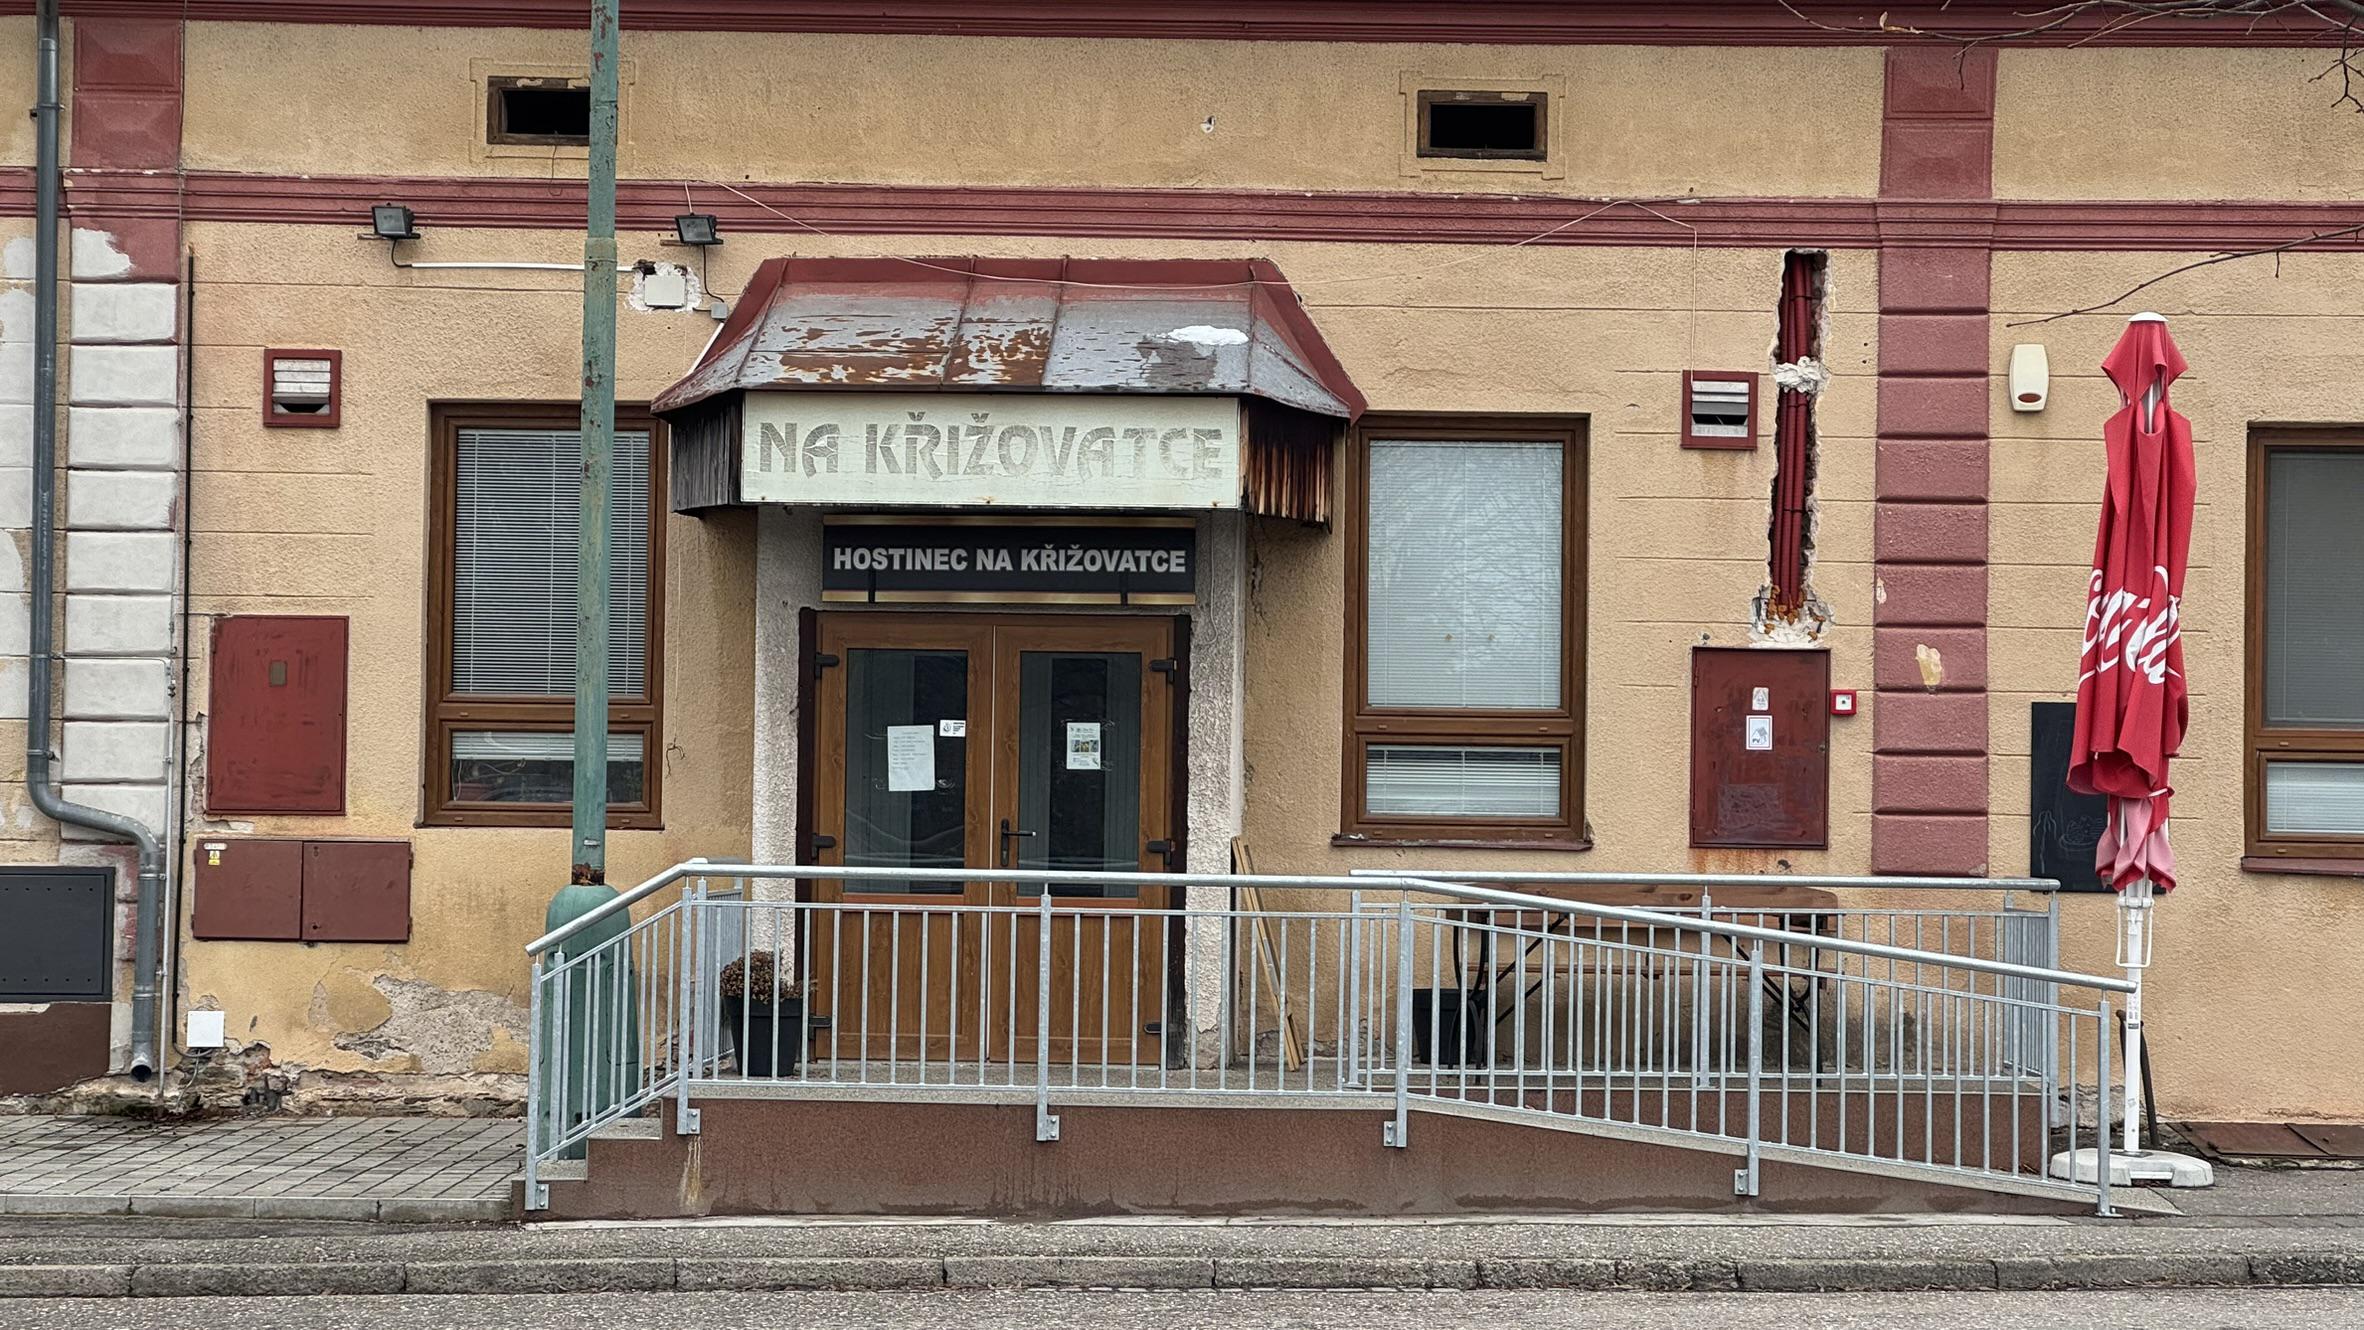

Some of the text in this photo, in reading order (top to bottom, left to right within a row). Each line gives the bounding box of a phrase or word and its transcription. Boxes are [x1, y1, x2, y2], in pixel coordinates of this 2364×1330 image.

[759, 411, 1223, 482] NA KŘIŽOVATCE
[833, 544, 1186, 573] HOSTINEC NA KŘIŽOVATCE
